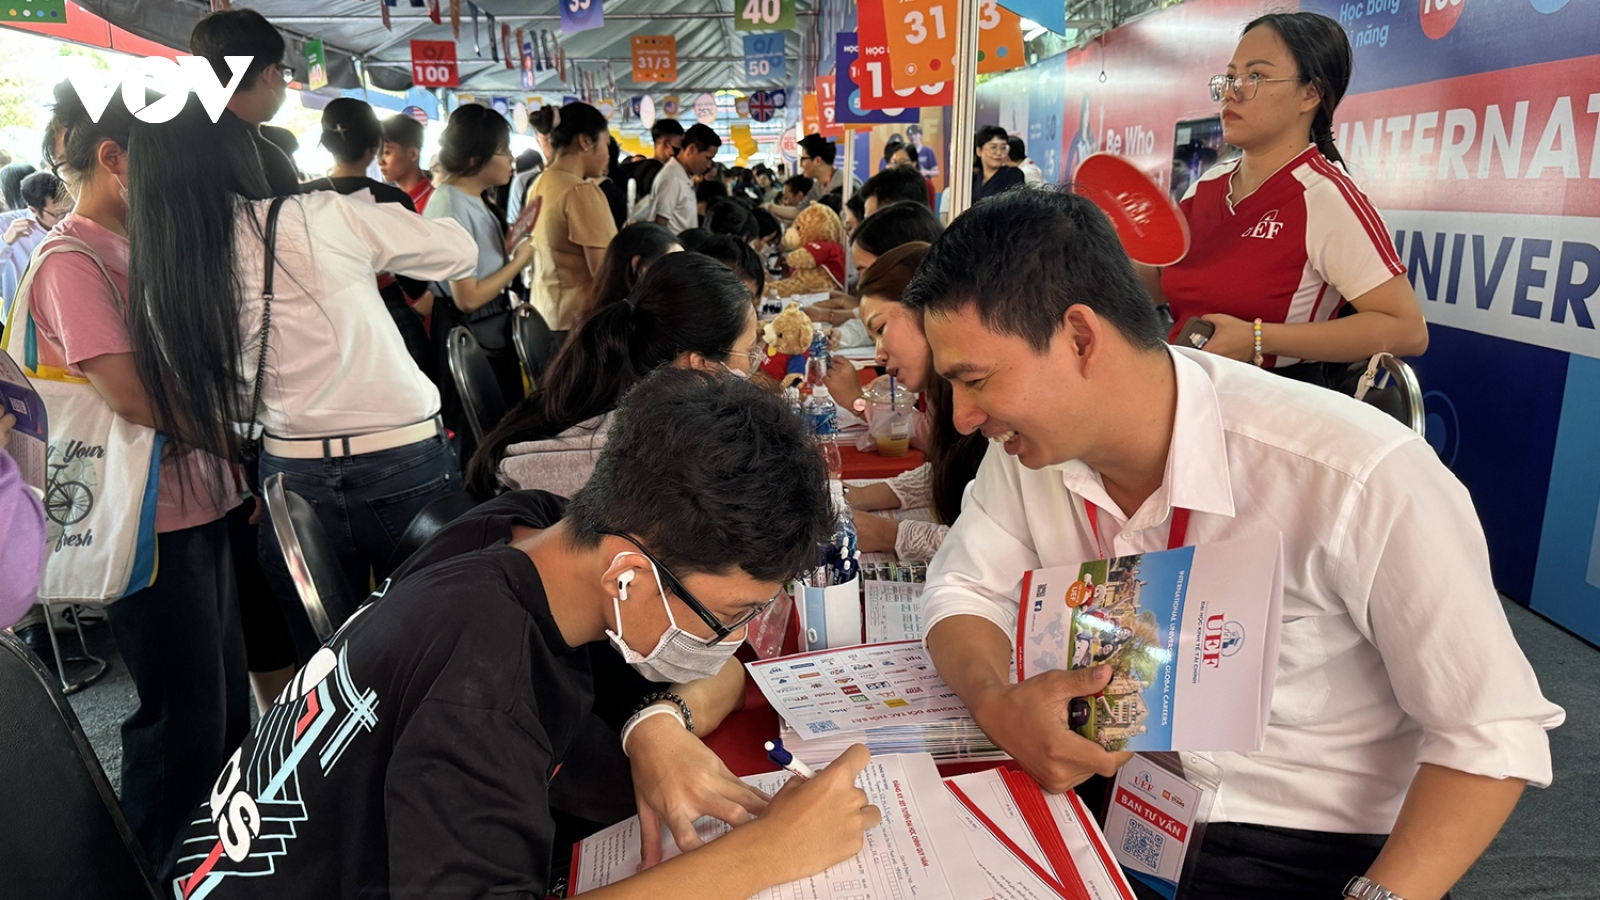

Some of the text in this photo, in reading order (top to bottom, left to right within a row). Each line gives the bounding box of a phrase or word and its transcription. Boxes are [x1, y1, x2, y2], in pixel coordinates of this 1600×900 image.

[1355, 24, 1389, 48] năng
[415, 66, 449, 82] 100
[638, 57, 671, 69] 31/3
[749, 60, 770, 76] 50
[1106, 125, 1154, 155] Be Who
[63, 440, 104, 463] Your
[54, 529, 93, 553] fresh
[1171, 570, 1185, 622] INTERNATIONAL
[1203, 614, 1225, 668] UEF
[1163, 665, 1171, 694] GLOBAL
[1161, 694, 1169, 726] CAREERS
[1135, 776, 1155, 792] UEF
[1121, 794, 1181, 837] BAN TƯ VẤN
